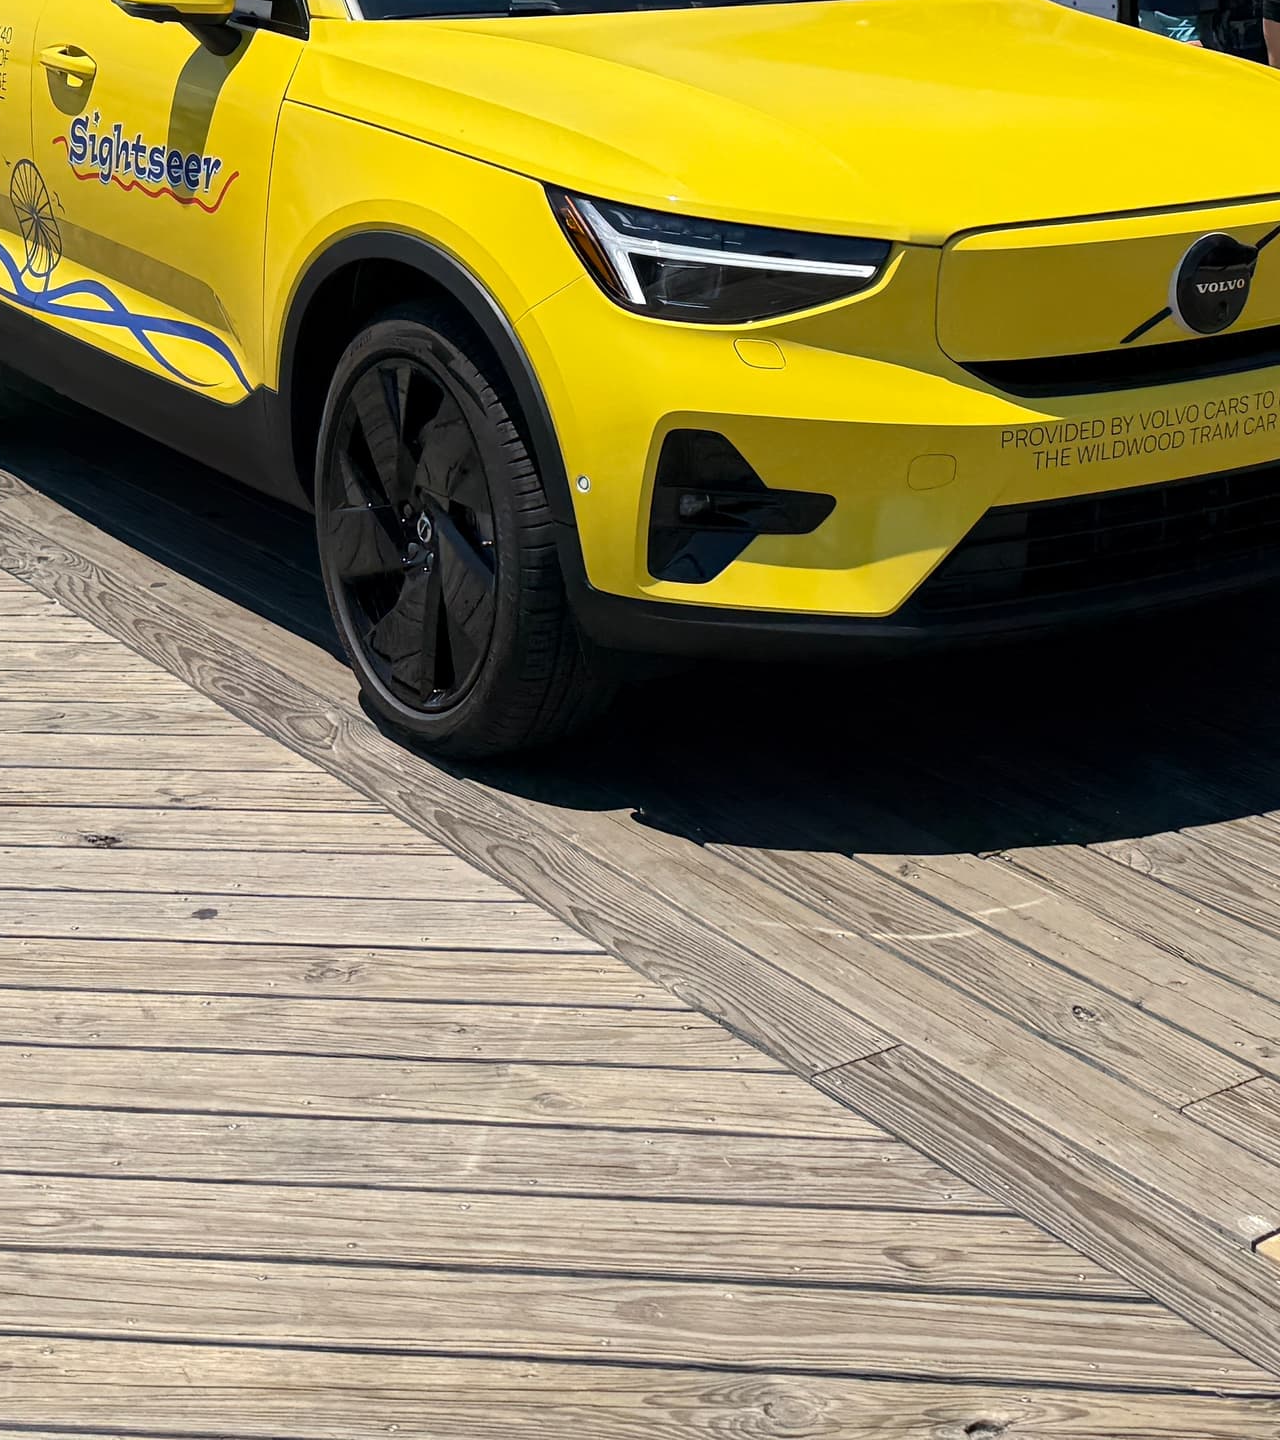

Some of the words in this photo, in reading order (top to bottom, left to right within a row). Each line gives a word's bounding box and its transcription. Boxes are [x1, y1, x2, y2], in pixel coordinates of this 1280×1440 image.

[68, 110, 222, 193] Sightseer
[1195, 278, 1245, 294] VOLVO
[1001, 419, 1106, 448] PROVIDED
[1111, 415, 1135, 436] BY
[1139, 404, 1199, 431] VOLVO
[1204, 395, 1249, 420] CARS
[1253, 390, 1275, 410] TO
[1032, 447, 1072, 470] THE
[1077, 430, 1185, 464] WILDWOOD
[1189, 421, 1239, 446] TRAM
[1243, 412, 1277, 436] CAR
